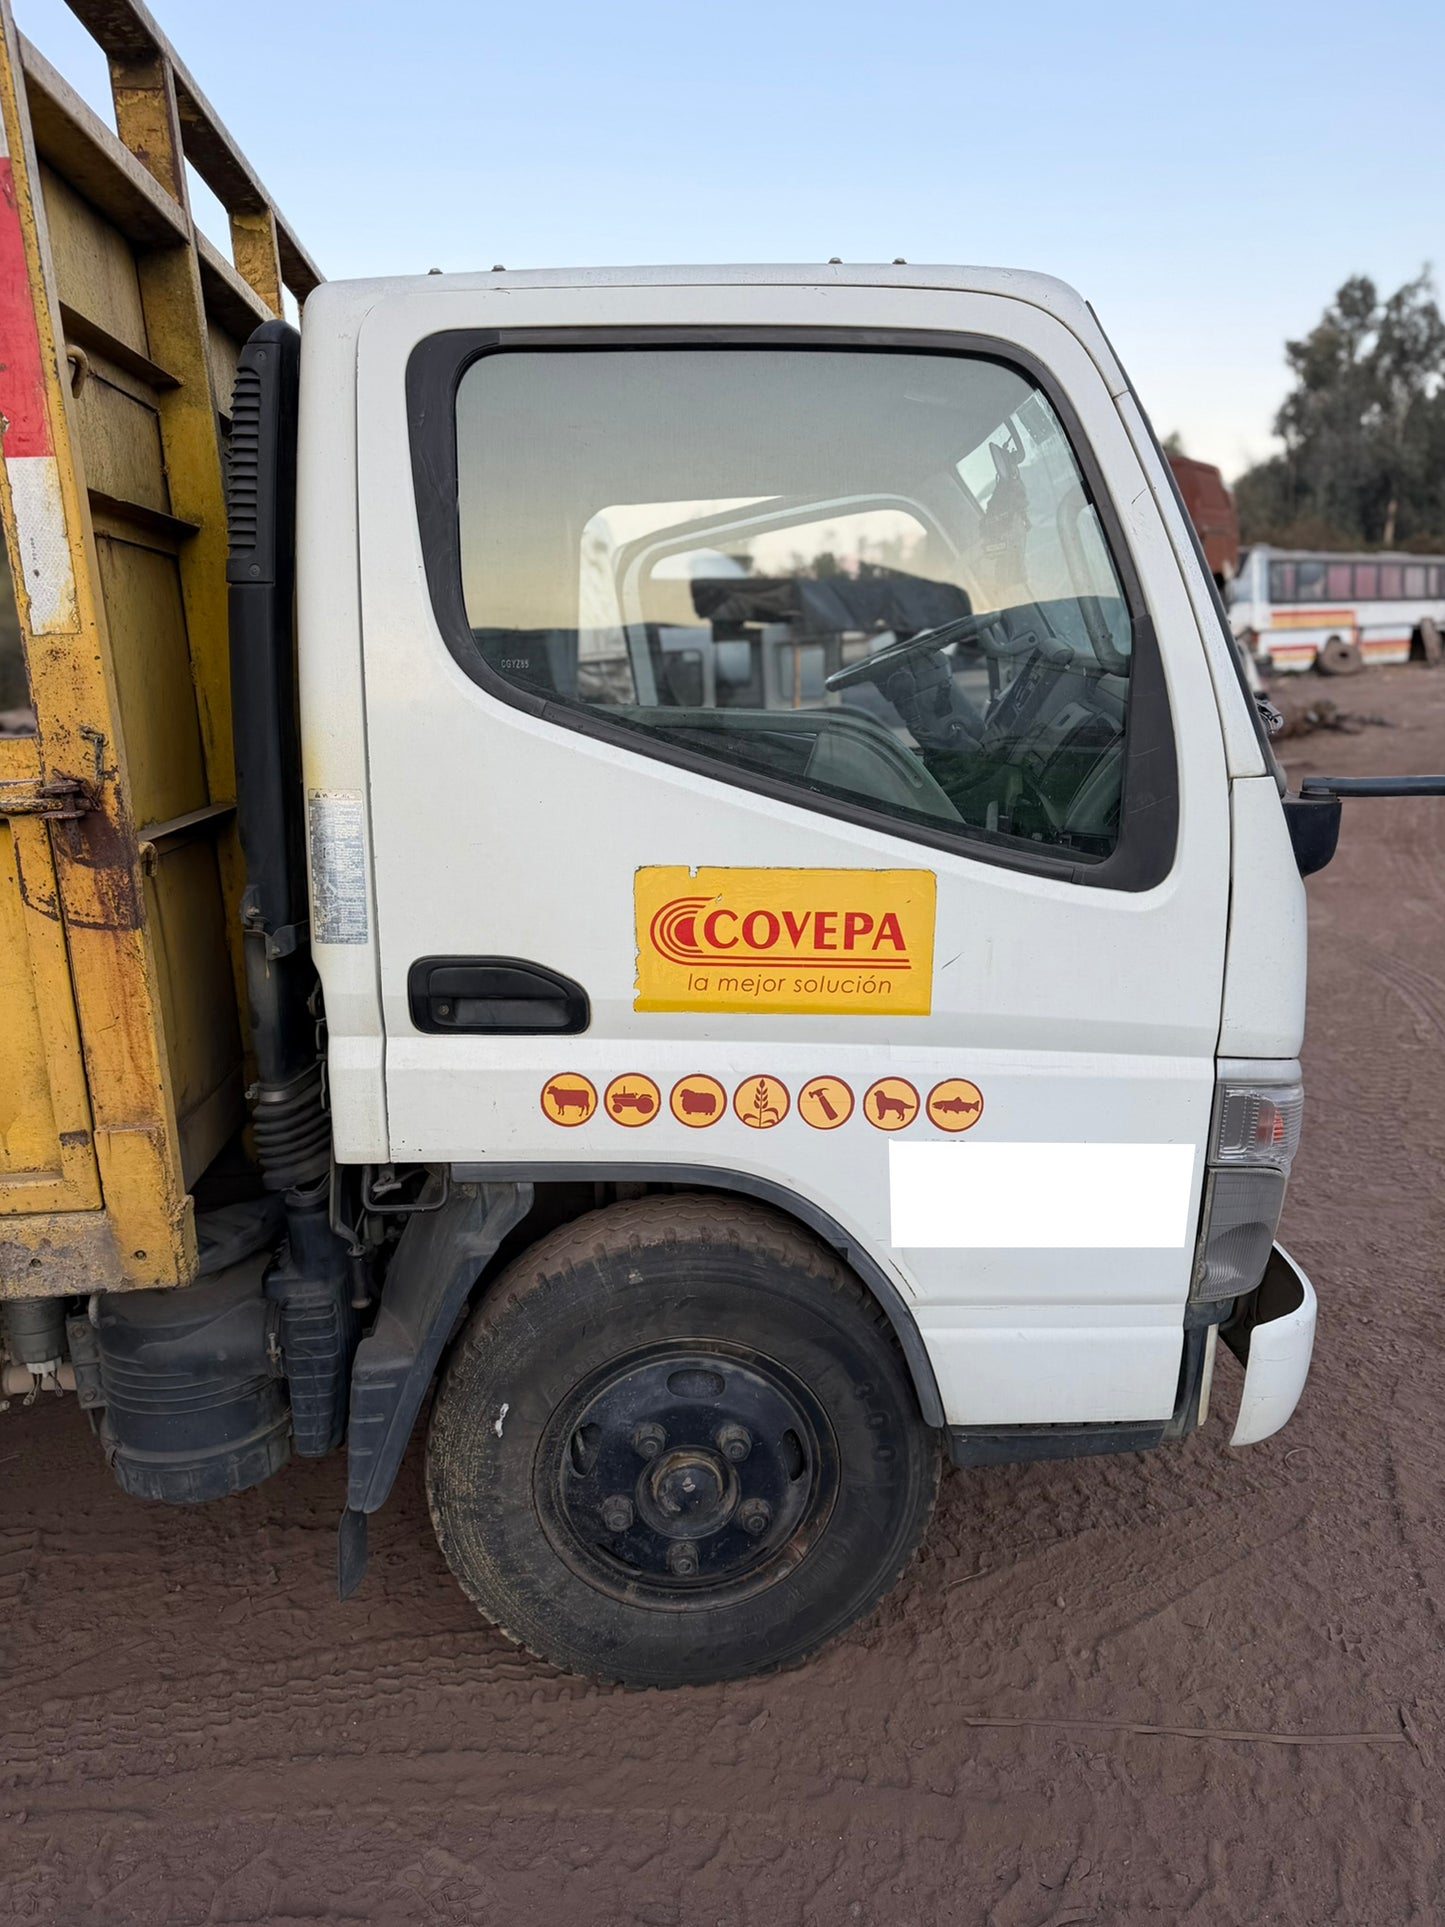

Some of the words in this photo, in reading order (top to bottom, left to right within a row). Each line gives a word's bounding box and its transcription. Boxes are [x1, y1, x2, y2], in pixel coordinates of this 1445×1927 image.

[704, 910, 906, 951] COVEPA
[688, 974, 708, 992] la
[718, 974, 786, 997] mejor
[793, 974, 892, 995] solución
